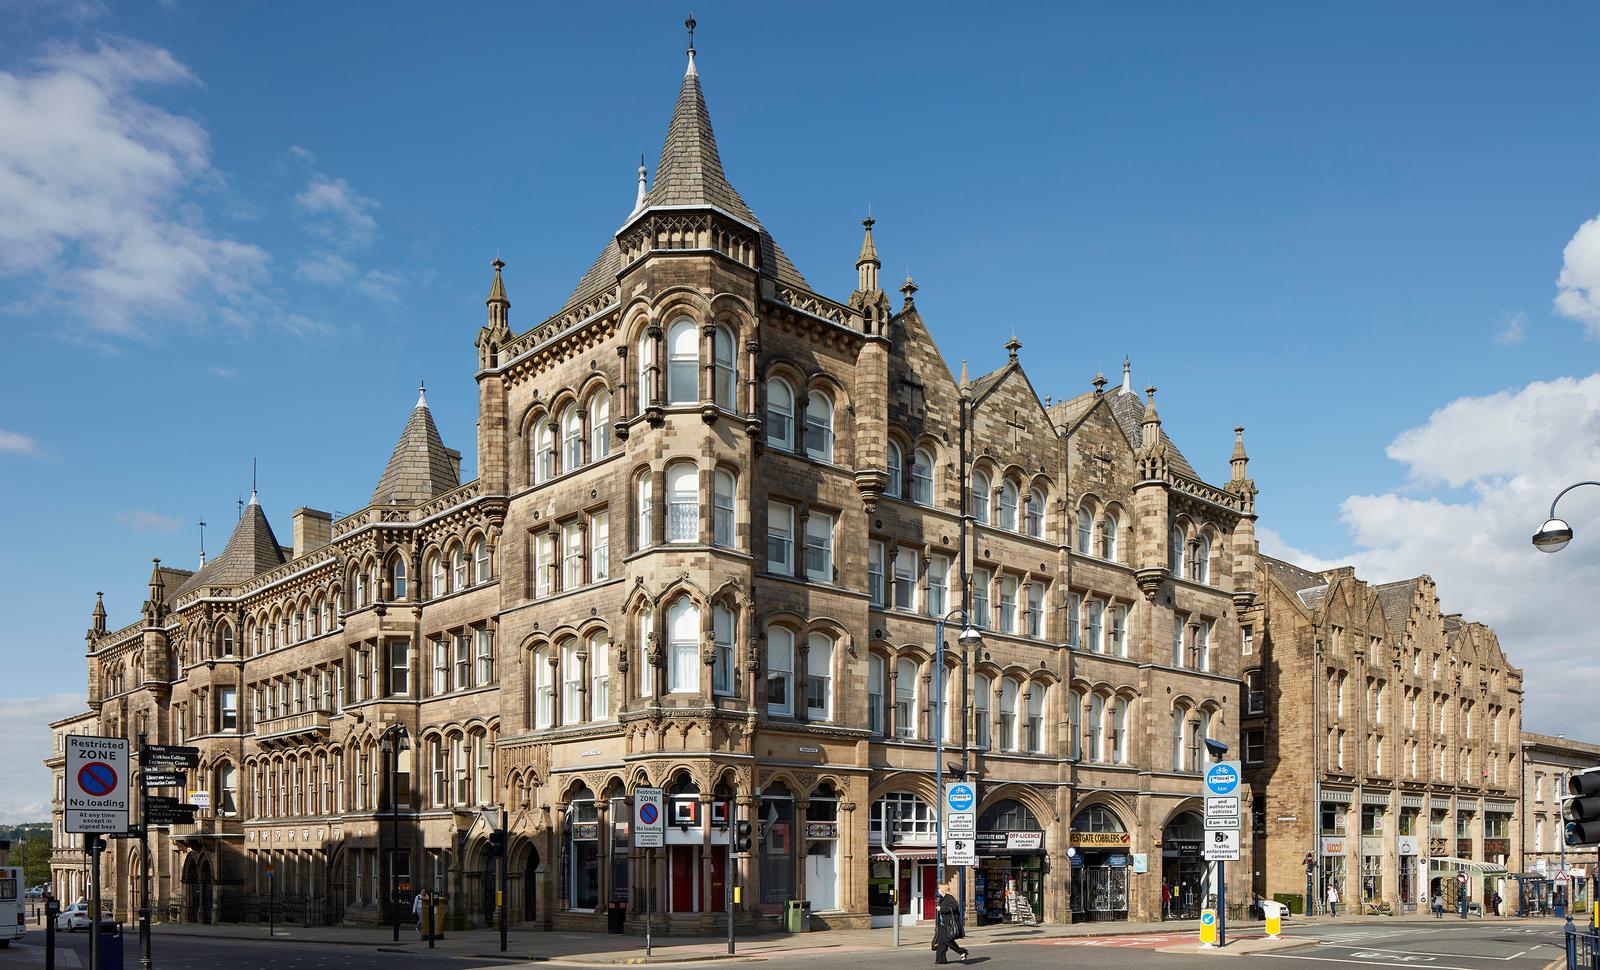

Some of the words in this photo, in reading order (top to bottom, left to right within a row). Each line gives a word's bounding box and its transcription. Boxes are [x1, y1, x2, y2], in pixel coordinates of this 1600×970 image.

[71, 738, 124, 750] Restricted
[78, 750, 117, 760] ZONE
[88, 799, 124, 808] loading
[1095, 834, 1120, 843] COBBLERS
